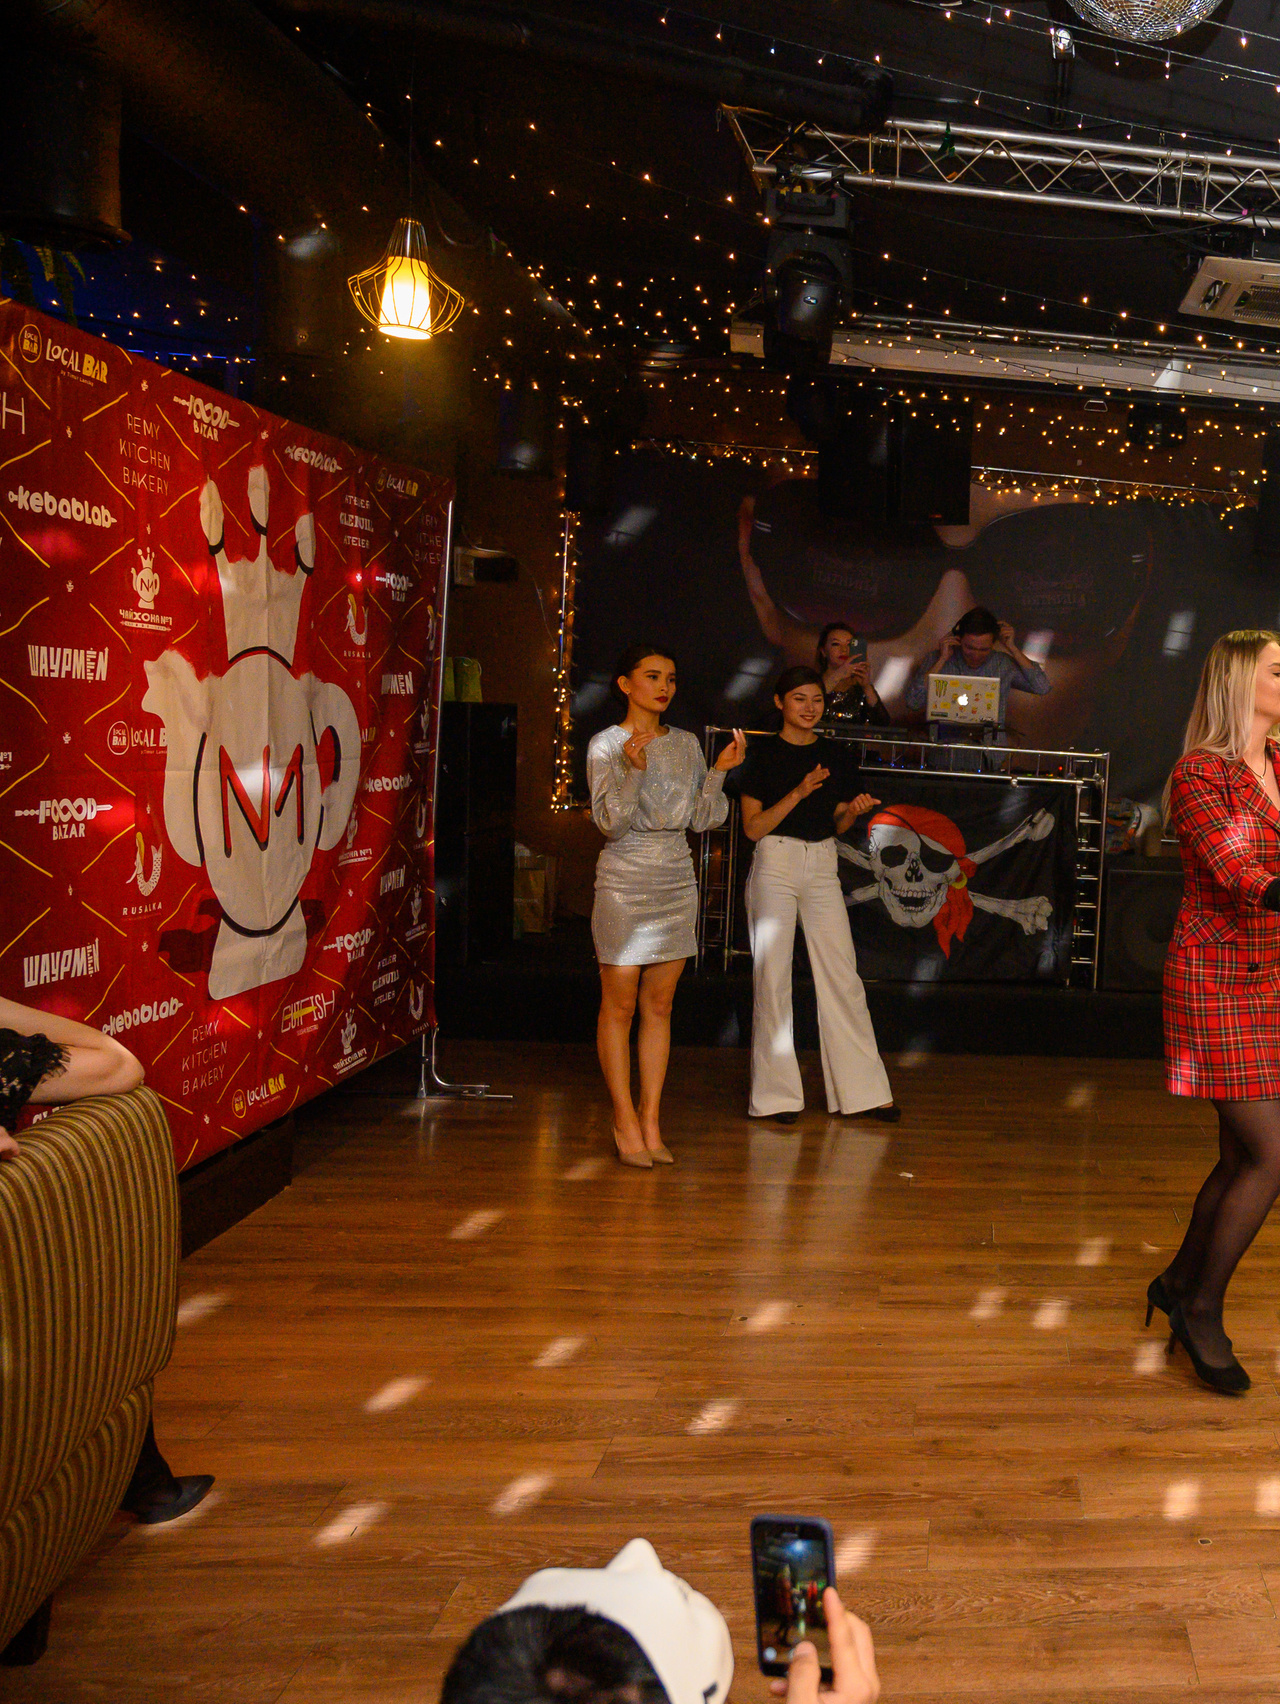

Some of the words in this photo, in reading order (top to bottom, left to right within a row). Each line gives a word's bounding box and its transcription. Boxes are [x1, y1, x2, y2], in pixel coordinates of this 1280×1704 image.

[46, 338, 81, 372] LOCAL
[82, 353, 108, 384] BAR
[127, 413, 160, 440] REMY
[119, 438, 171, 471] KITCHEN
[123, 466, 169, 496] BAKERY
[18, 485, 112, 528] kebablab
[119, 608, 160, 624] ЧАЙХОНА
[112, 736, 126, 746] BAR
[131, 727, 157, 748] LOCAL
[52, 823, 86, 841] BAZAR
[122, 901, 163, 916] RUSALKA
[109, 996, 181, 1037] kebablab
[191, 1019, 220, 1044] REMY
[181, 1040, 228, 1072] KITCHEN
[182, 1064, 225, 1096] BAKERY
[247, 1083, 270, 1107] LOCAL
[268, 1073, 287, 1095] BAR
